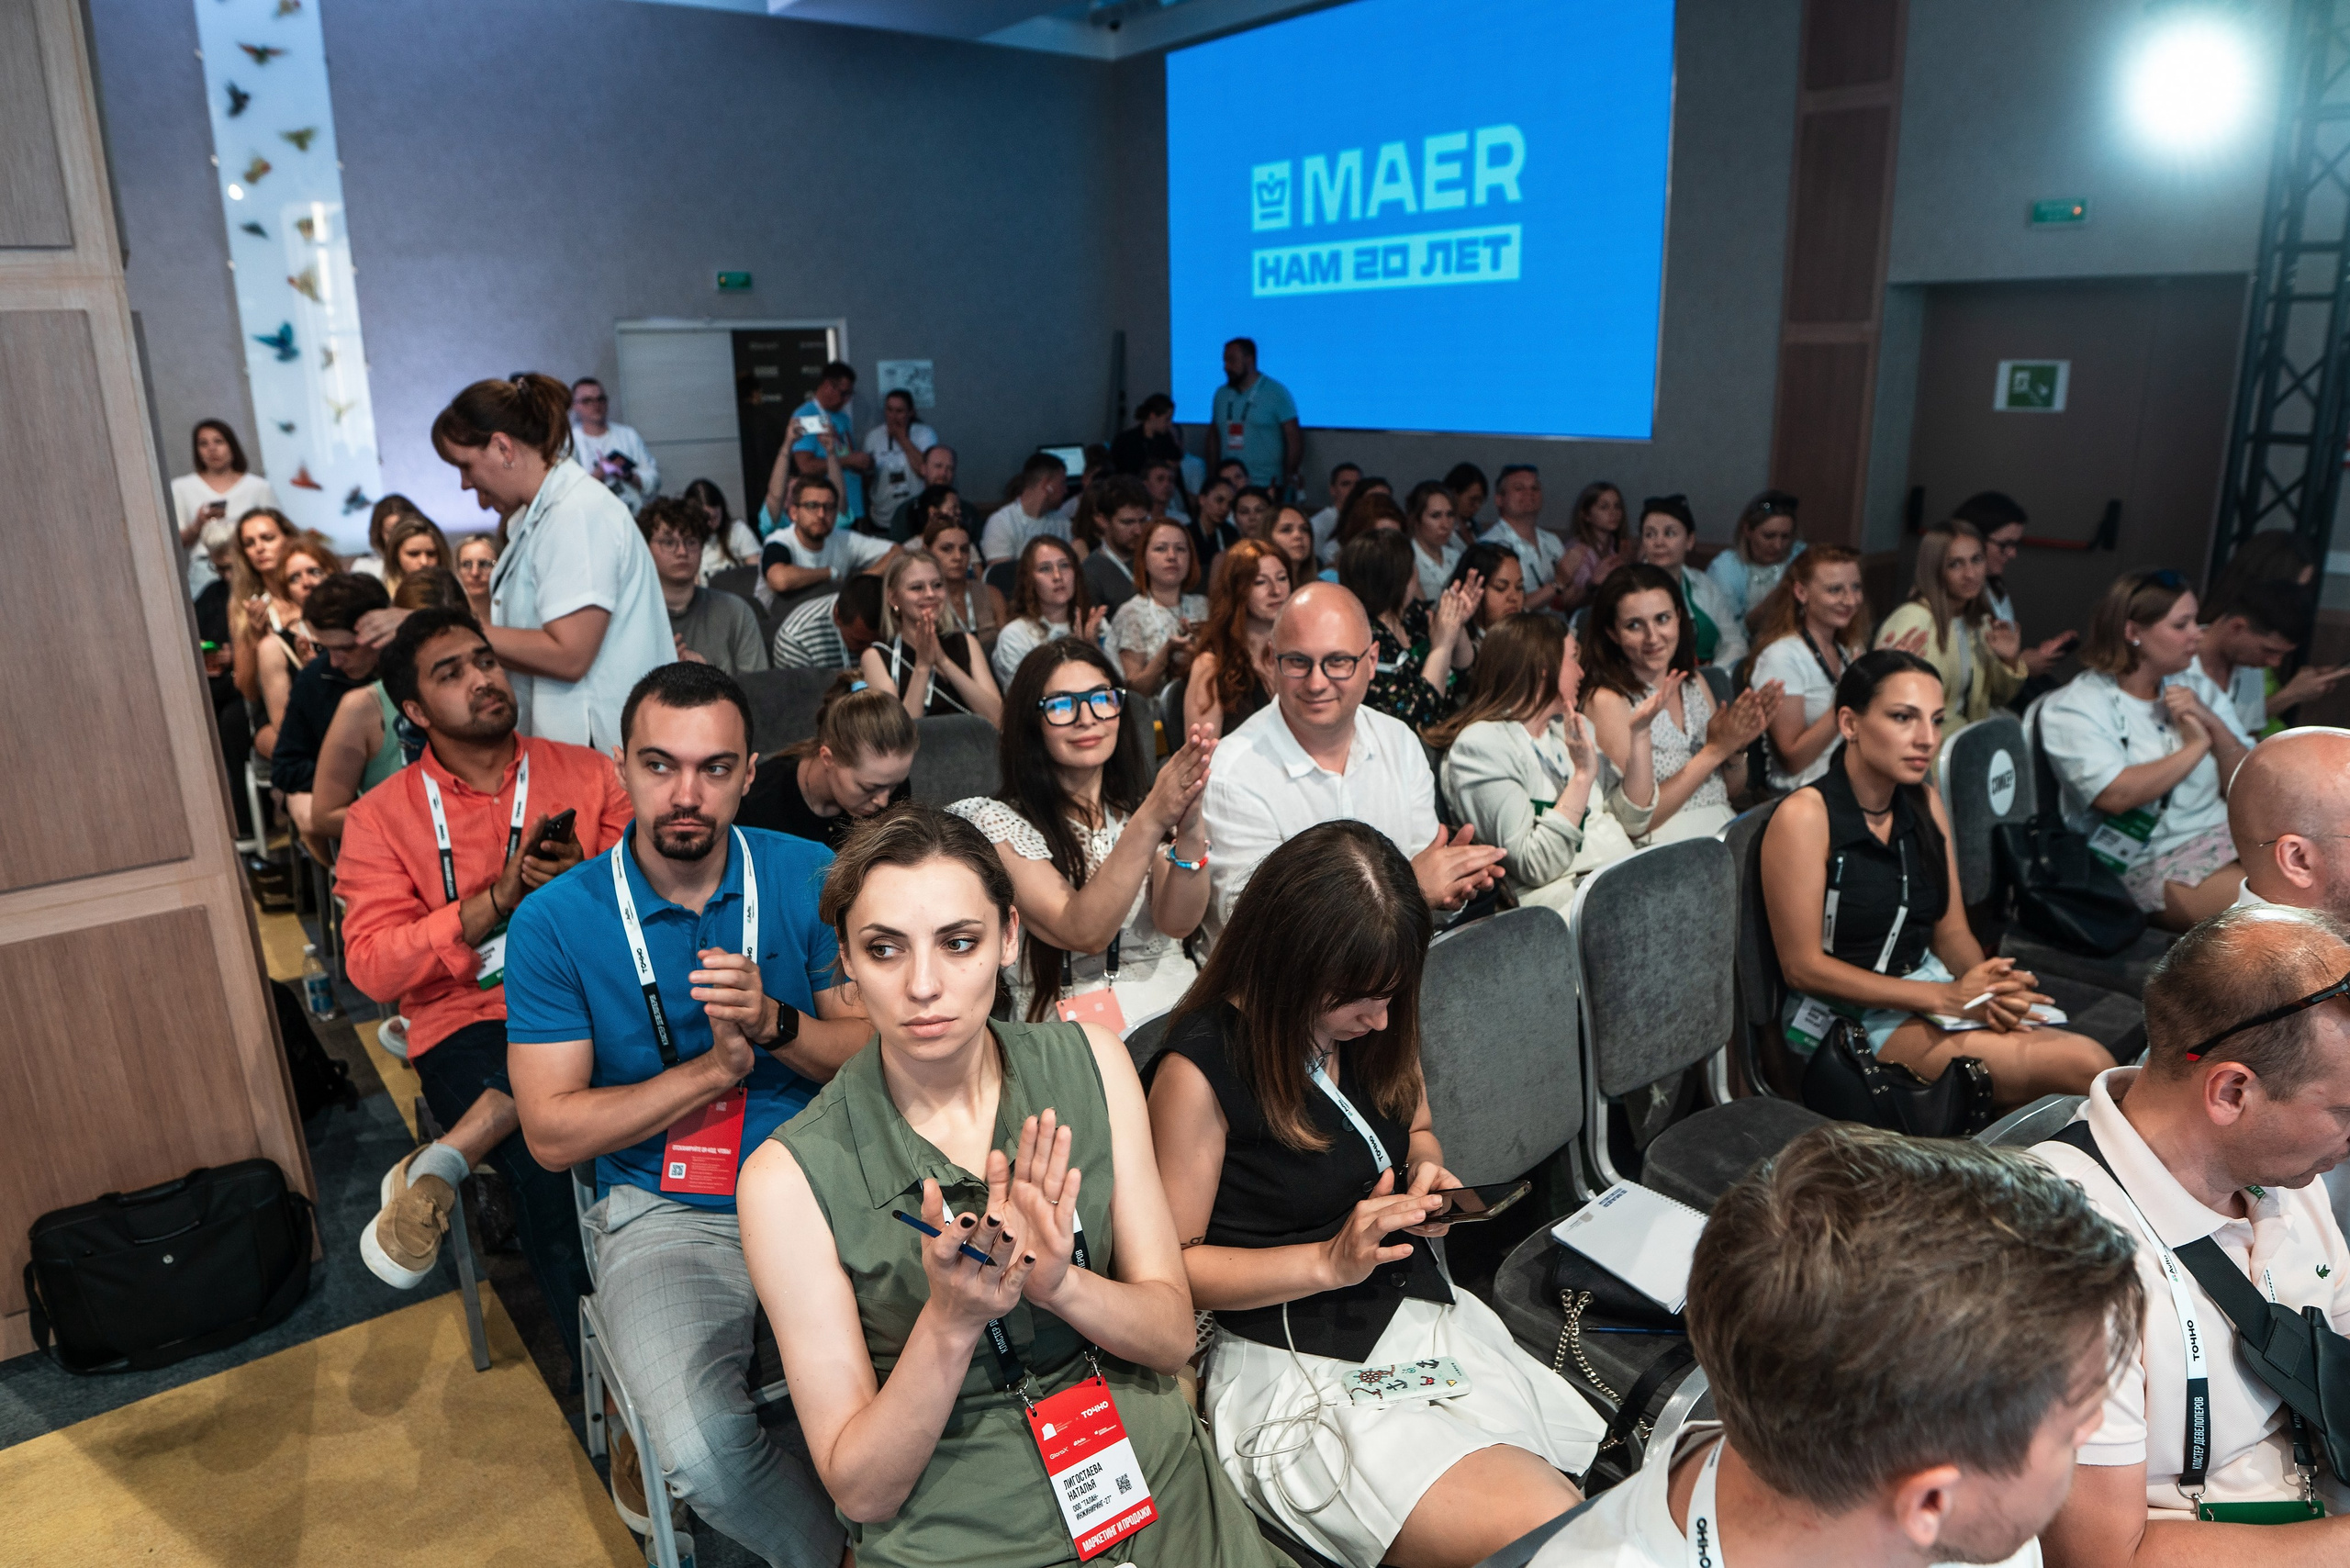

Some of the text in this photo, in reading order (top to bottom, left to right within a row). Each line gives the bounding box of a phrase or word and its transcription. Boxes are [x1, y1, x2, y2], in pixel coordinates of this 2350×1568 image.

[1302, 122, 1527, 228] MAER
[1259, 233, 1513, 290] НАМ 20 ЛЕТ
[636, 947, 648, 974] ТОЧНО
[1369, 1135, 1383, 1162] ТОЧНО
[991, 1327, 1009, 1354] КЛАСТЕР
[2187, 1319, 2199, 1361] ТОЧНО
[1080, 1400, 1109, 1419] ТОЧНО
[2192, 1396, 2205, 1470] КЛАСТЕР ДЕВЕЛОПЕРОВ
[1063, 1462, 1103, 1491] ЛИГОСТАЕВА
[1067, 1478, 1097, 1502] НАТАЛЬЯ
[1072, 1504, 1082, 1513] ООО
[1081, 1505, 1153, 1552] МАРКЕТИНГ И ПРОДАЖИ
[1696, 1518, 1711, 1568] ОЧНО
